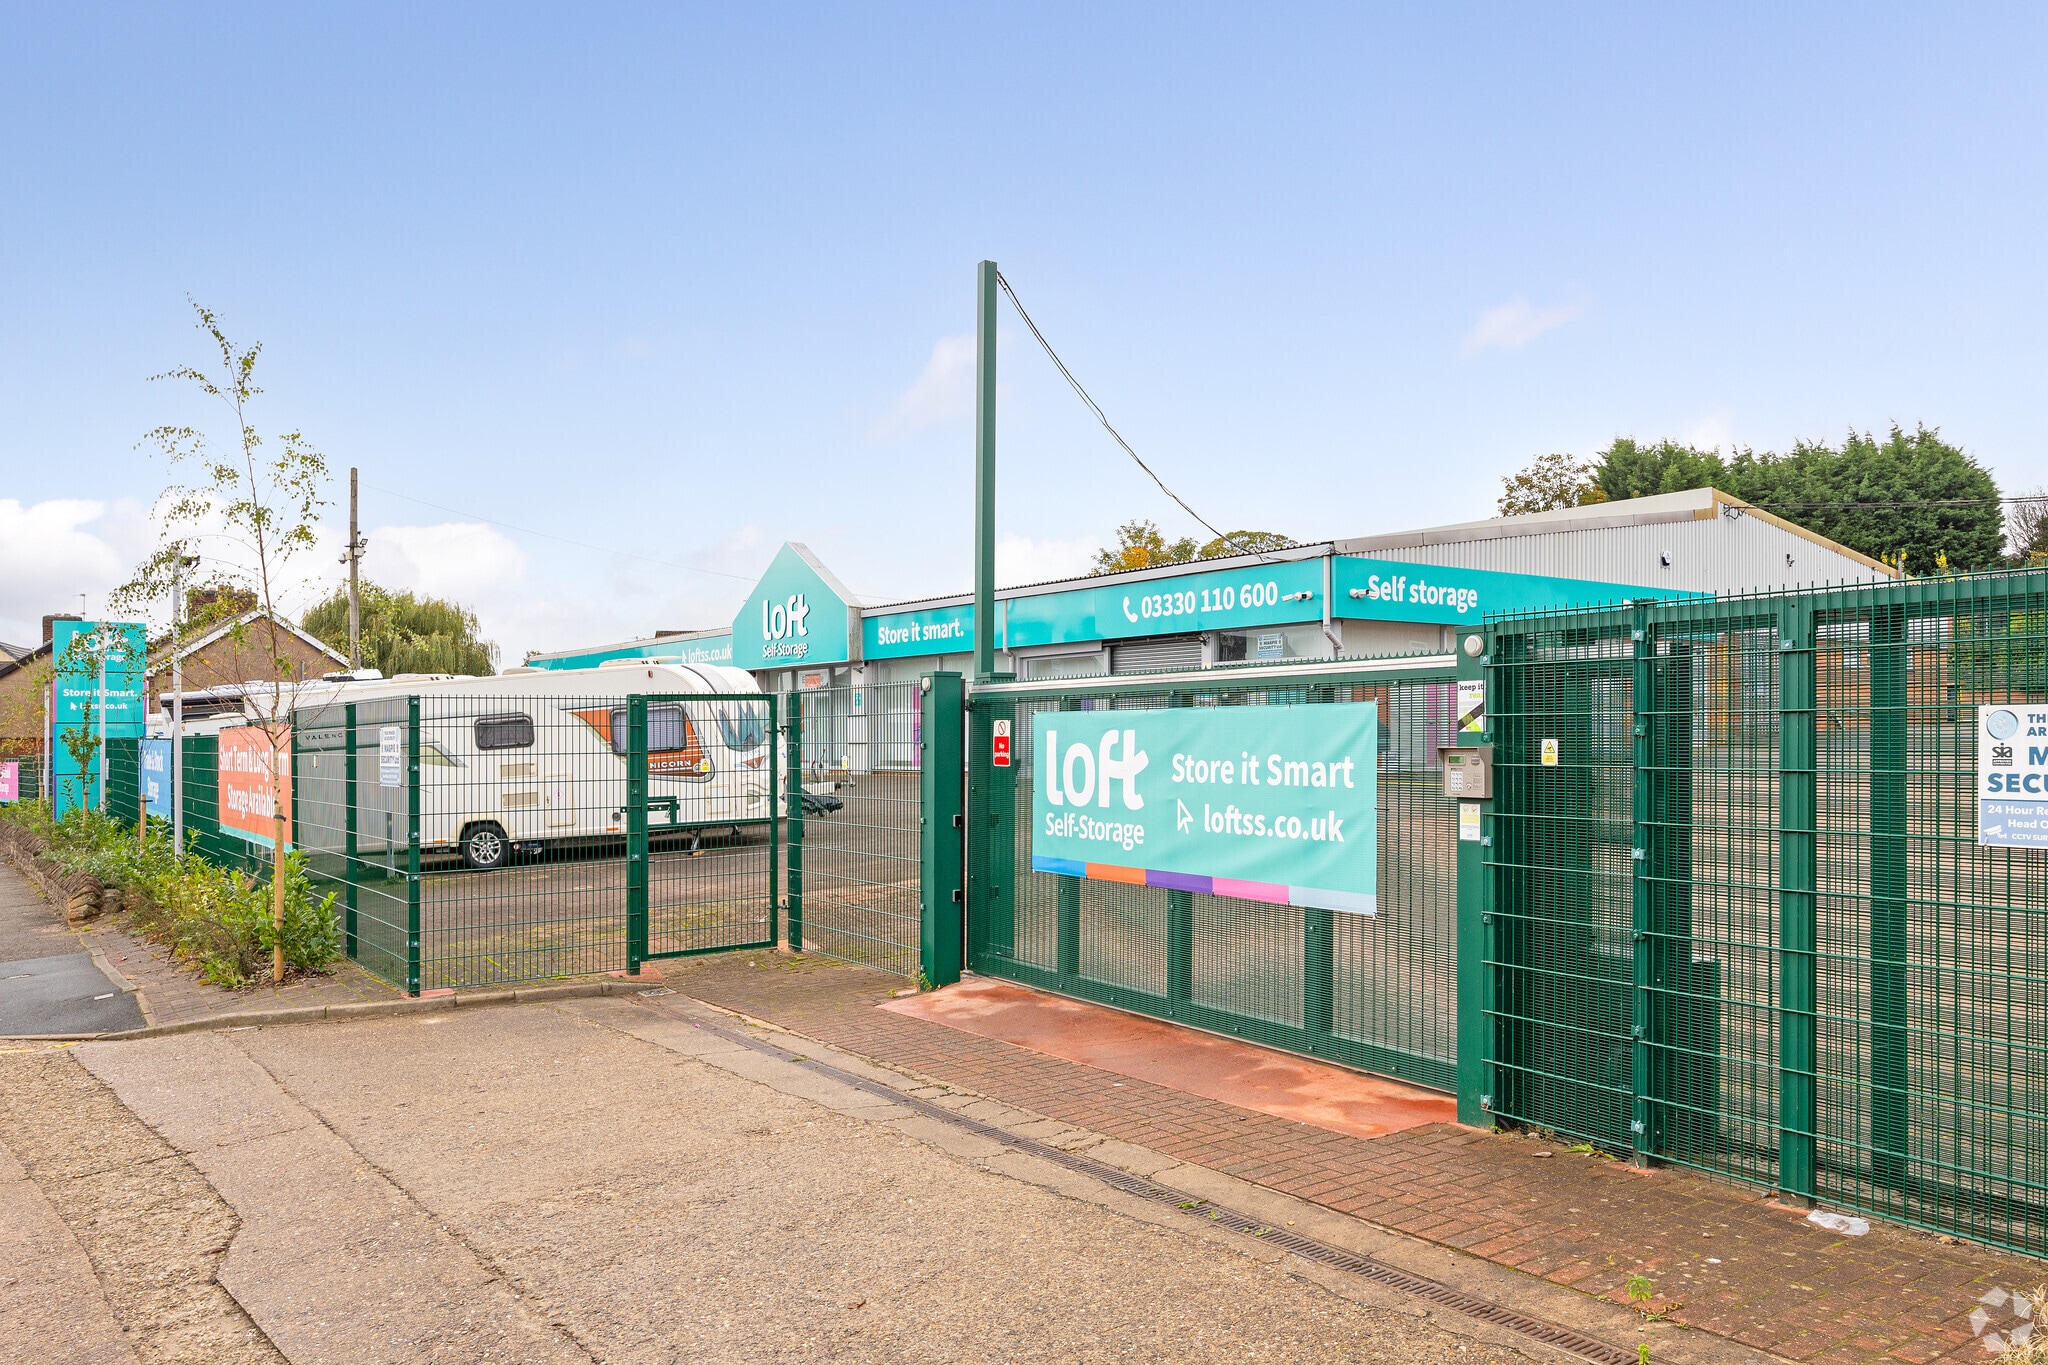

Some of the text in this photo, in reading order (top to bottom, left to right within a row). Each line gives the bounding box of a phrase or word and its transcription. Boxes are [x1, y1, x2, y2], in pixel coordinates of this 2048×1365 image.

[1141, 581, 1278, 619] 03330 110 600
[1368, 575, 1478, 613] Self storage
[762, 593, 810, 641] loft
[878, 618, 964, 645] Store it smart.
[688, 643, 732, 663] loftss.co.uk
[763, 642, 808, 658] Self-Storage
[63, 688, 91, 697] Store
[104, 688, 137, 697] Smart.
[2027, 714, 2046, 723] TH
[305, 732, 343, 741] VALENC
[2027, 727, 2047, 736] AR
[1992, 743, 2013, 758] sia
[2029, 746, 2048, 765] M
[220, 744, 233, 772] Short
[233, 745, 248, 772] Term
[254, 745, 269, 783] Long
[270, 744, 289, 776] Trm
[649, 760, 691, 769] NICORN
[1046, 729, 1149, 810] loft
[1172, 751, 1355, 788] Store it Smart
[1987, 773, 2048, 793] SEC
[227, 783, 248, 820] Storage
[1988, 805, 2002, 814] 24
[2005, 805, 2035, 815] Hour
[1045, 812, 1145, 850] Self-Storage
[1204, 803, 1344, 842] loftss.co.uk
[2008, 819, 2048, 829] Head O
